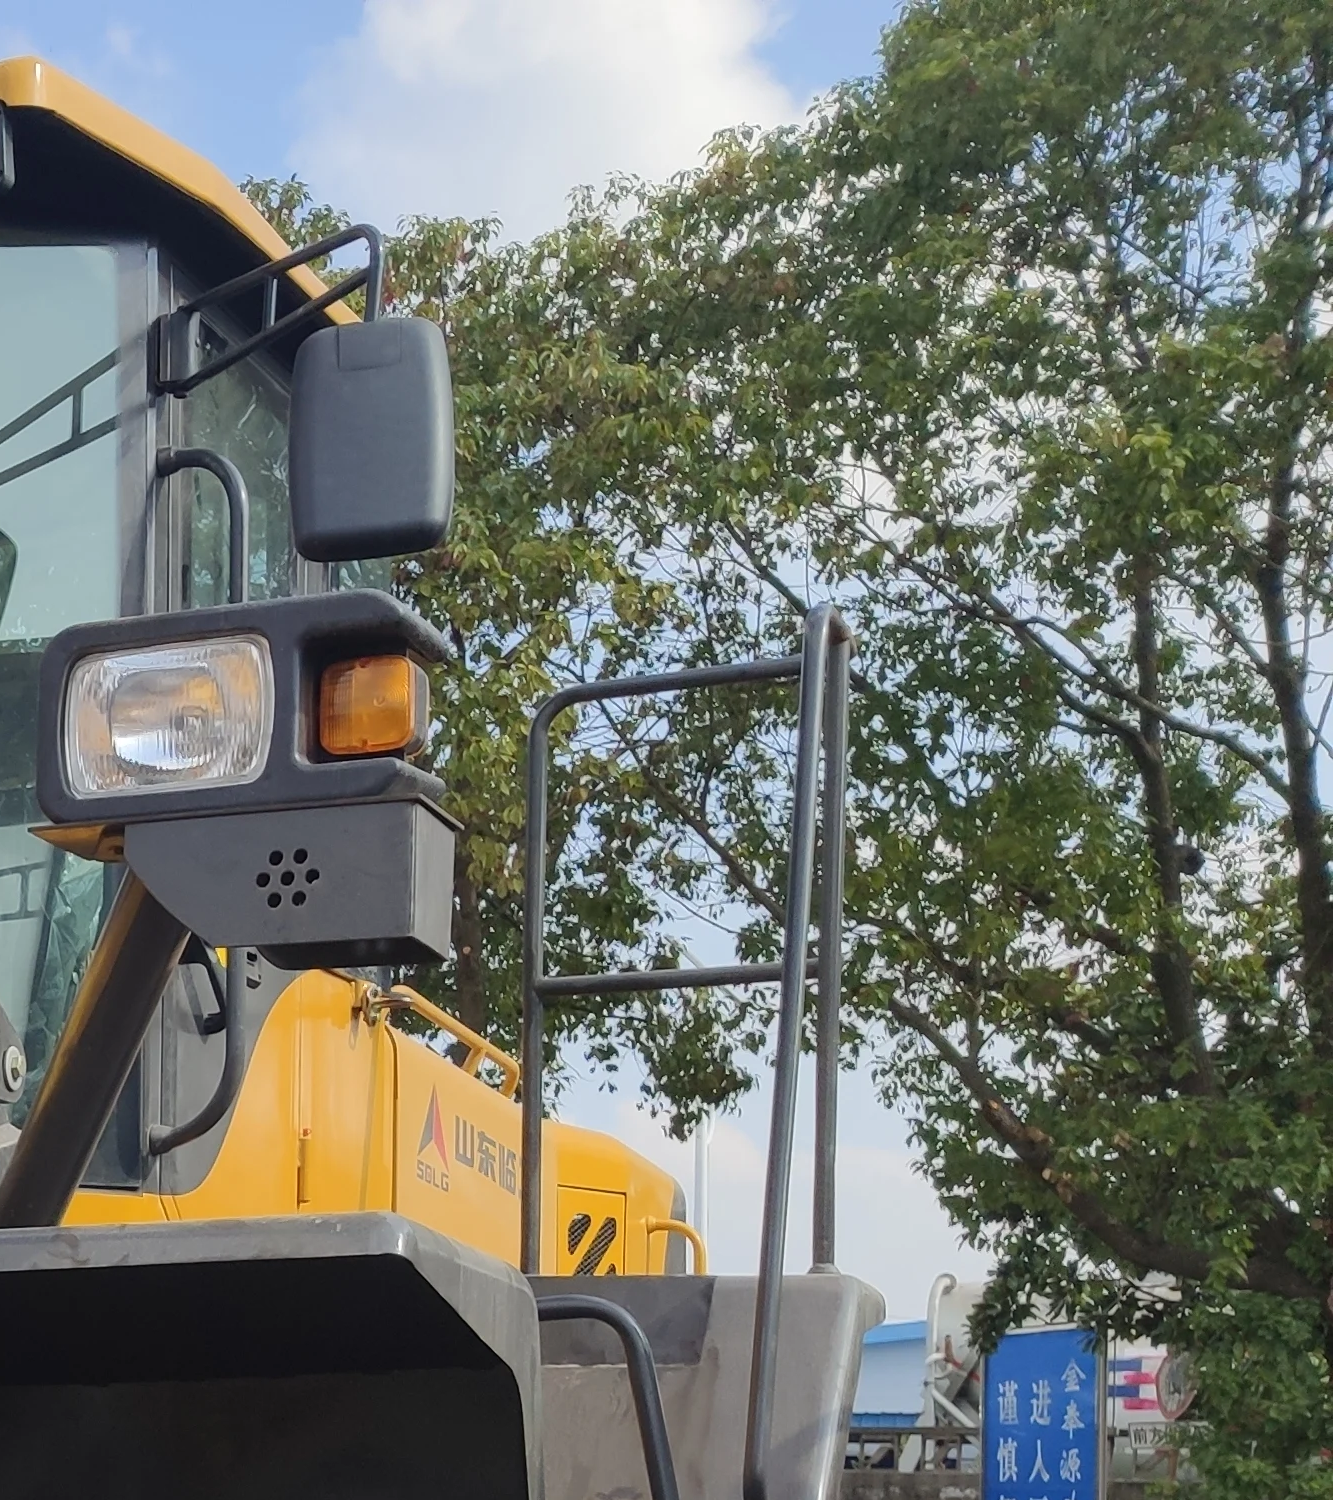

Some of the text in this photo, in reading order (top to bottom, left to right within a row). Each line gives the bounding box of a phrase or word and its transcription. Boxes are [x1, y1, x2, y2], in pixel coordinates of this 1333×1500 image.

[416, 1159, 450, 1193] SDLG
[454, 1114, 522, 1199] 山东临
